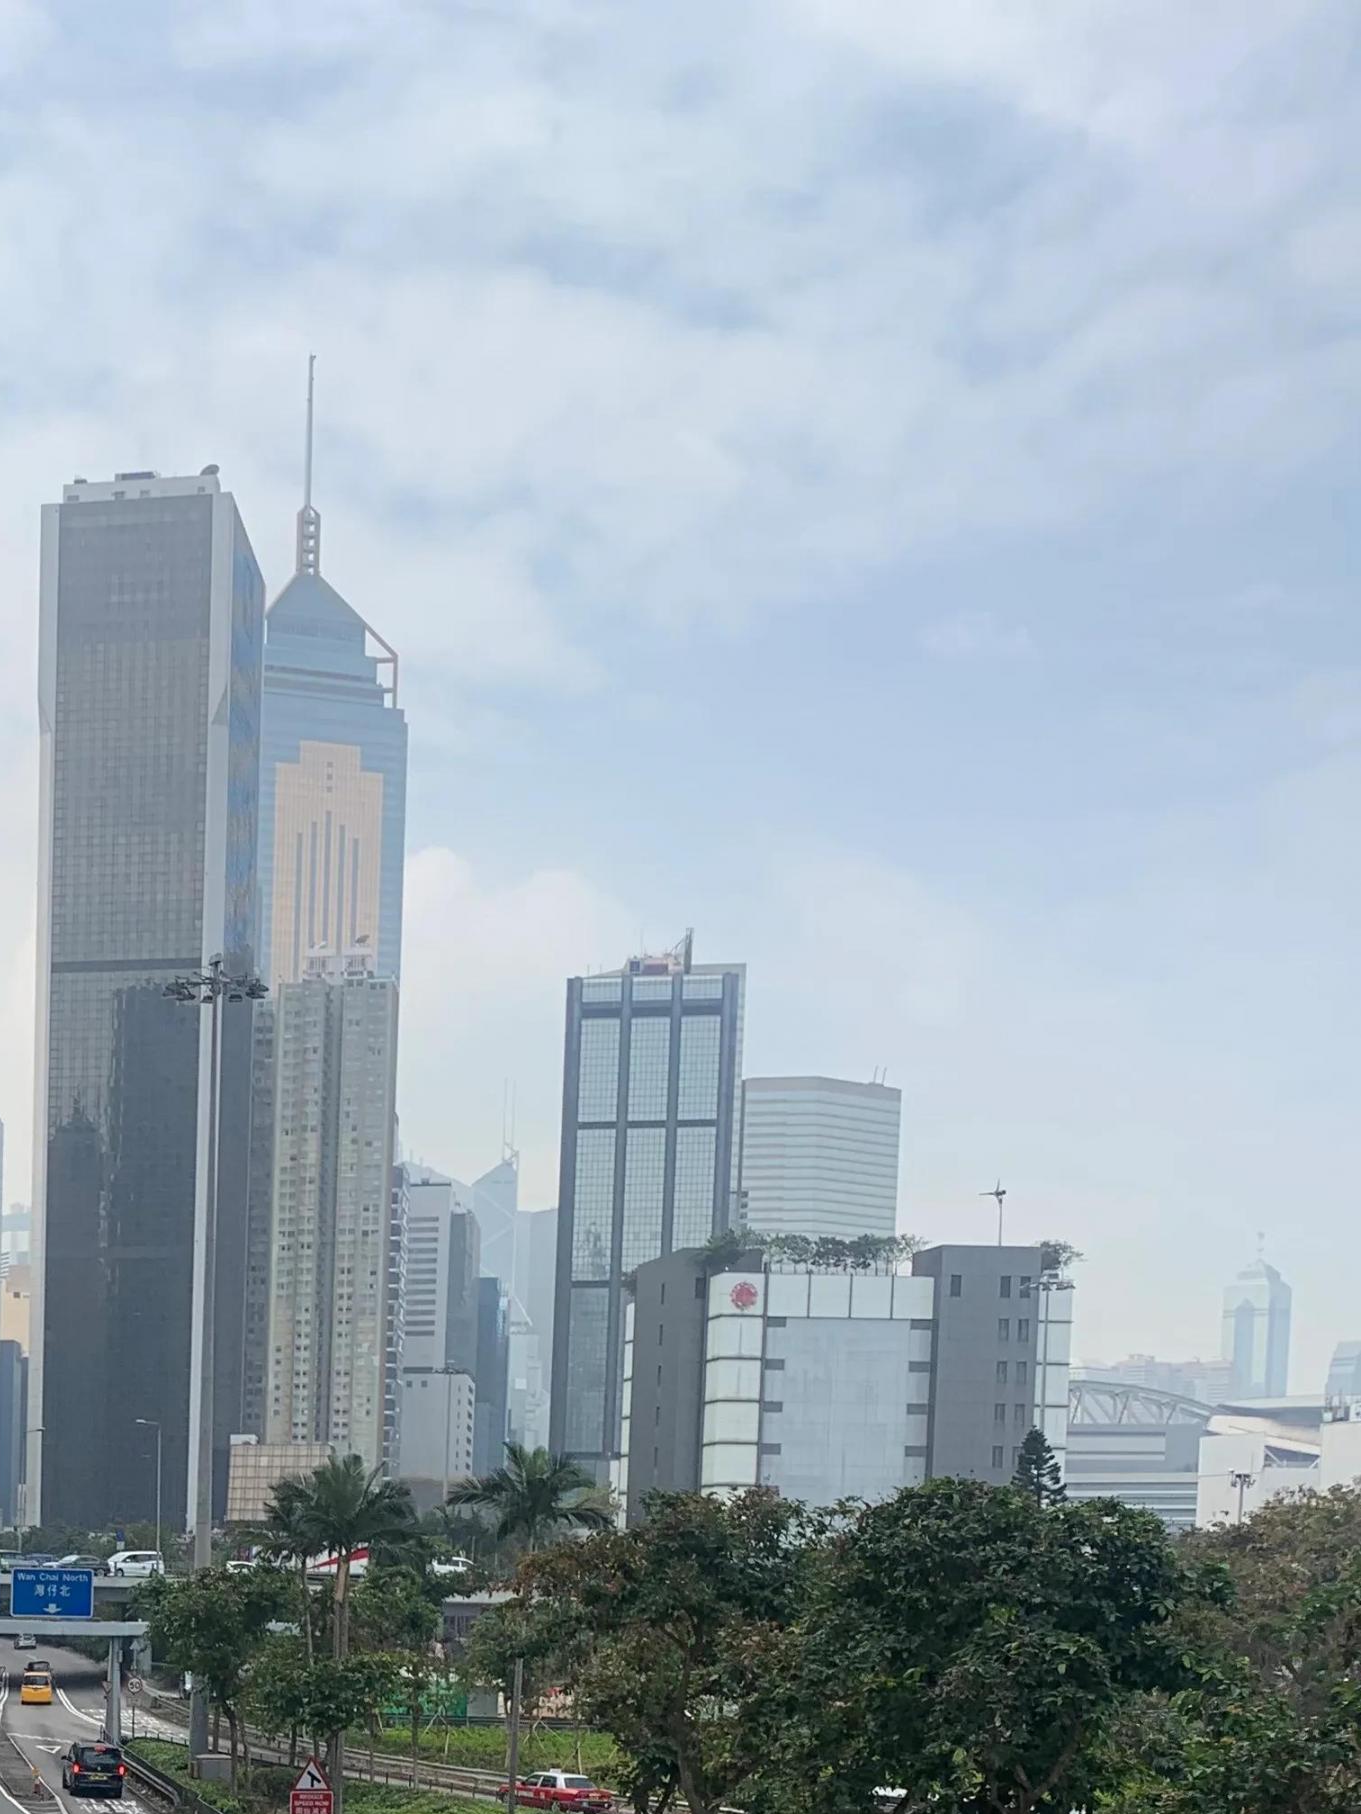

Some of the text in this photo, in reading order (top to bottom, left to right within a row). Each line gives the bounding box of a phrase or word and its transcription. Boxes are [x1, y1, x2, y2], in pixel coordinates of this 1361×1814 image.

[17, 1572, 89, 1582] Wan Chai North
[34, 1584, 71, 1597] 灣仔北
